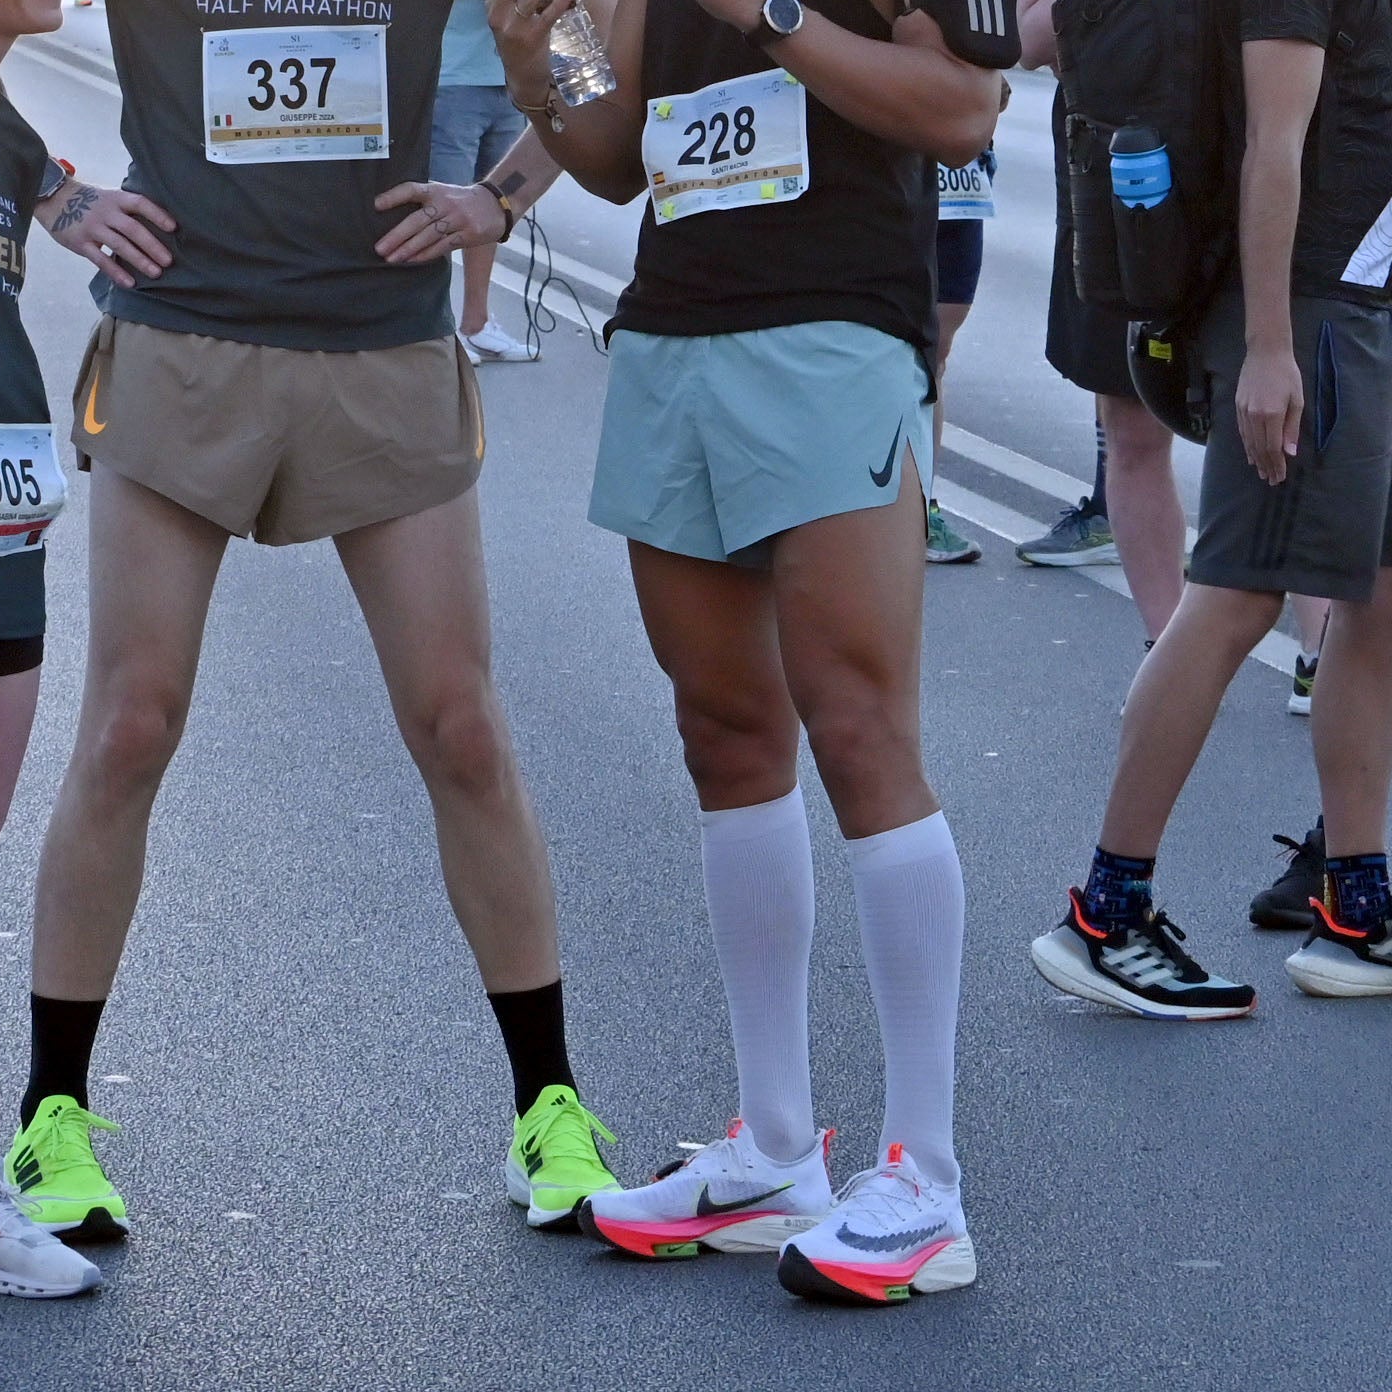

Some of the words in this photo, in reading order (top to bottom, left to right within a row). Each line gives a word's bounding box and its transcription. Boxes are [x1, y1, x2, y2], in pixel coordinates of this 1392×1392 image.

[247, 57, 337, 112] 337
[279, 112, 319, 122] GIUSEPPE
[676, 105, 757, 166] 228
